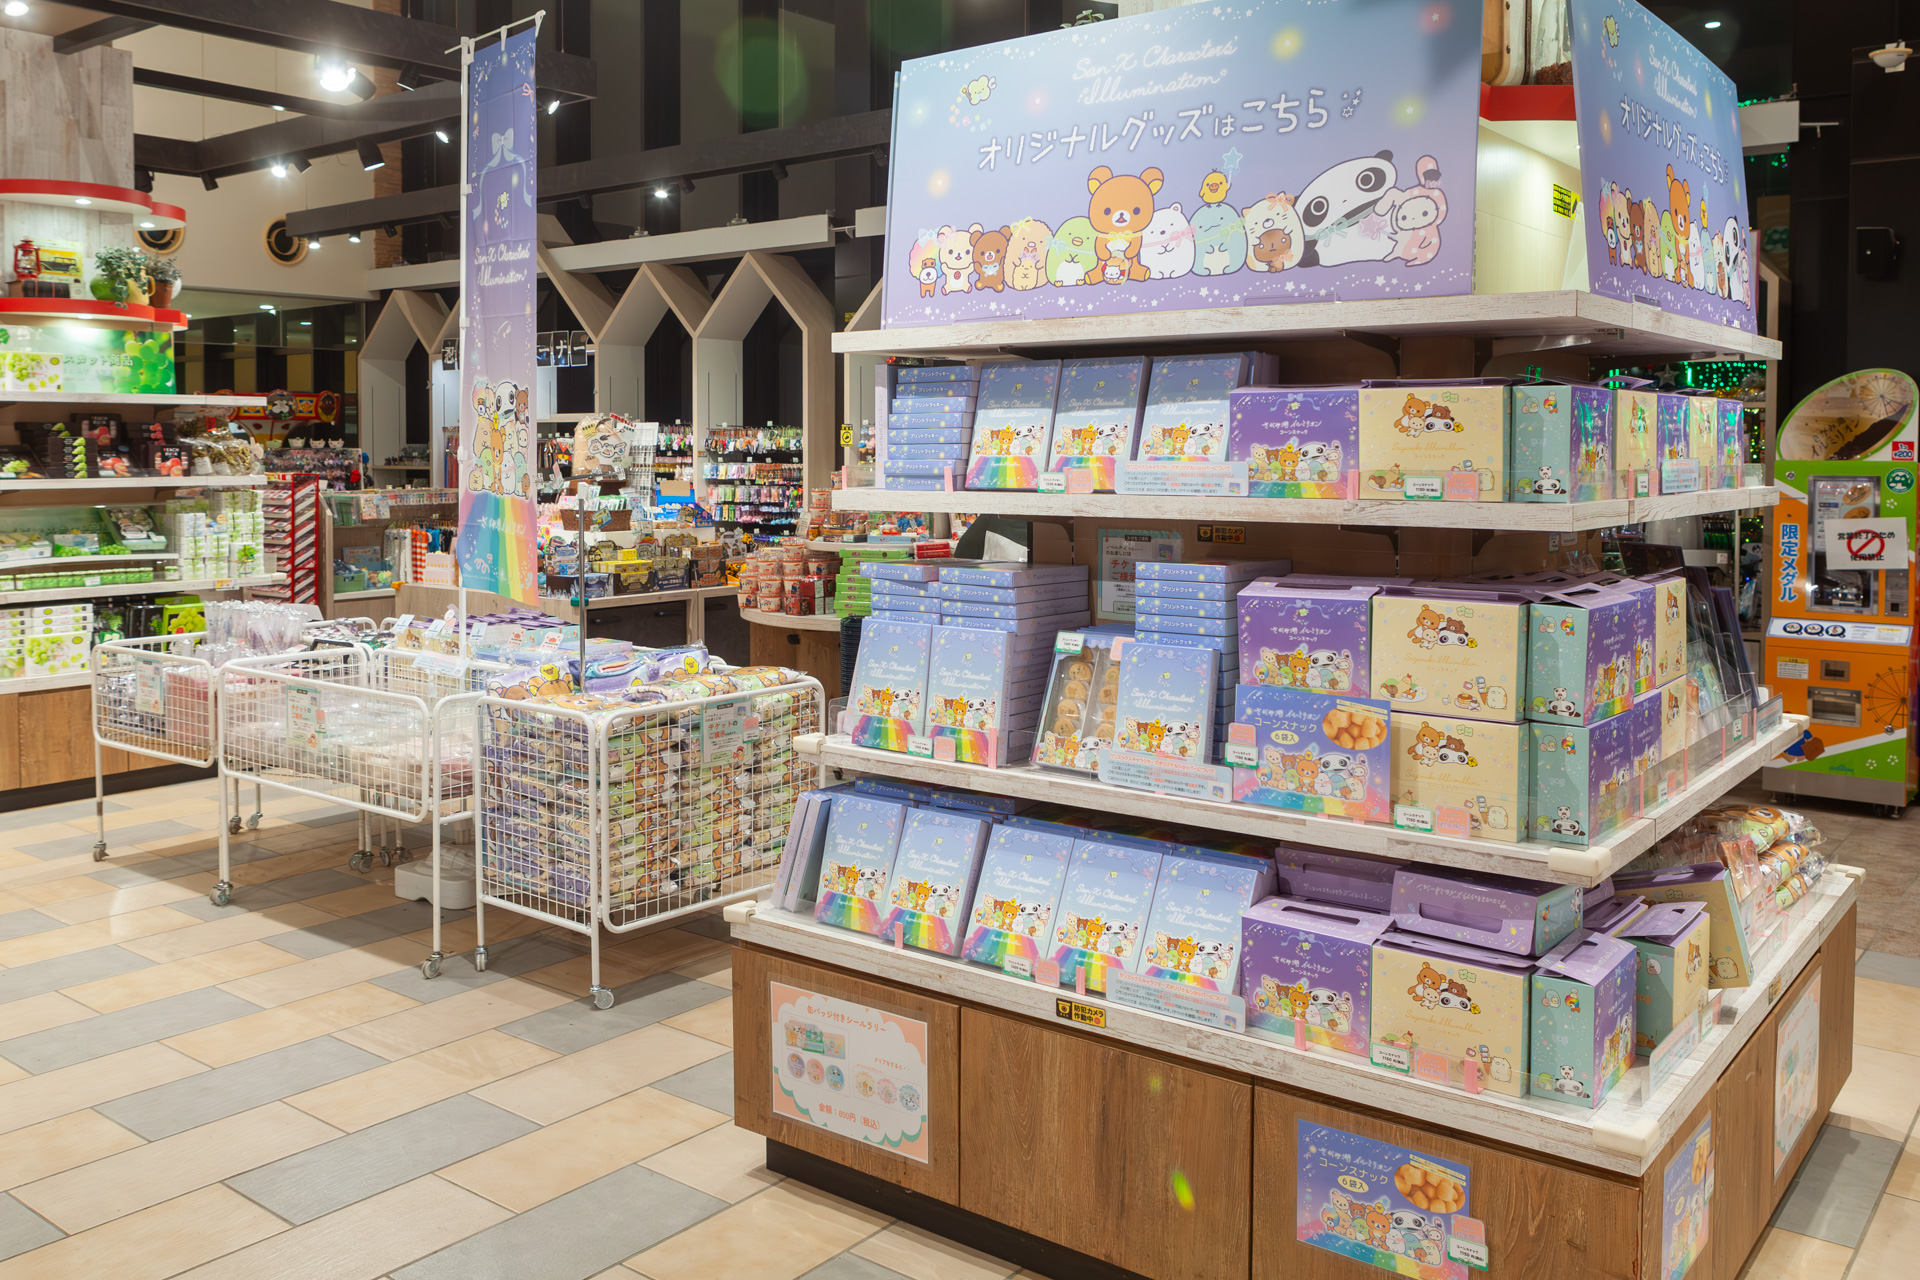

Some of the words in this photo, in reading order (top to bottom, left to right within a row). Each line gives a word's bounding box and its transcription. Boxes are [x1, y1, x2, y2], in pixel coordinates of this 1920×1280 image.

[1072, 52, 1137, 80] San-X
[1083, 71, 1221, 104] Illumination
[978, 88, 1330, 170] オリジナルグッズはこちら
[1620, 94, 1724, 184] オリジナルグッズはこちら
[474, 247, 495, 265] San-X
[479, 265, 525, 286] Illumination
[1780, 524, 1798, 602] 限定メダル
[1254, 708, 1284, 718] さがみ湖
[1286, 710, 1320, 720] イルミリオン
[709, 720, 738, 731] チケットの
[1254, 717, 1317, 733] コーンスナック
[1272, 955, 1300, 968] さがみ湖
[1301, 961, 1333, 974] イルミリオン
[1290, 967, 1318, 979] コーンスナック
[807, 1005, 887, 1032] 缶バッジ付きシールラリー
[1074, 1005, 1104, 1017] 防犯カメラ
[1074, 1012, 1093, 1022] 作動中
[1427, 1026, 1460, 1038] コーンスナック
[1318, 1147, 1351, 1163] さがみ湖
[1353, 1156, 1392, 1172] イルミリオン
[1320, 1157, 1388, 1184] コーンスナック
[1342, 1178, 1365, 1191] 6袋入
